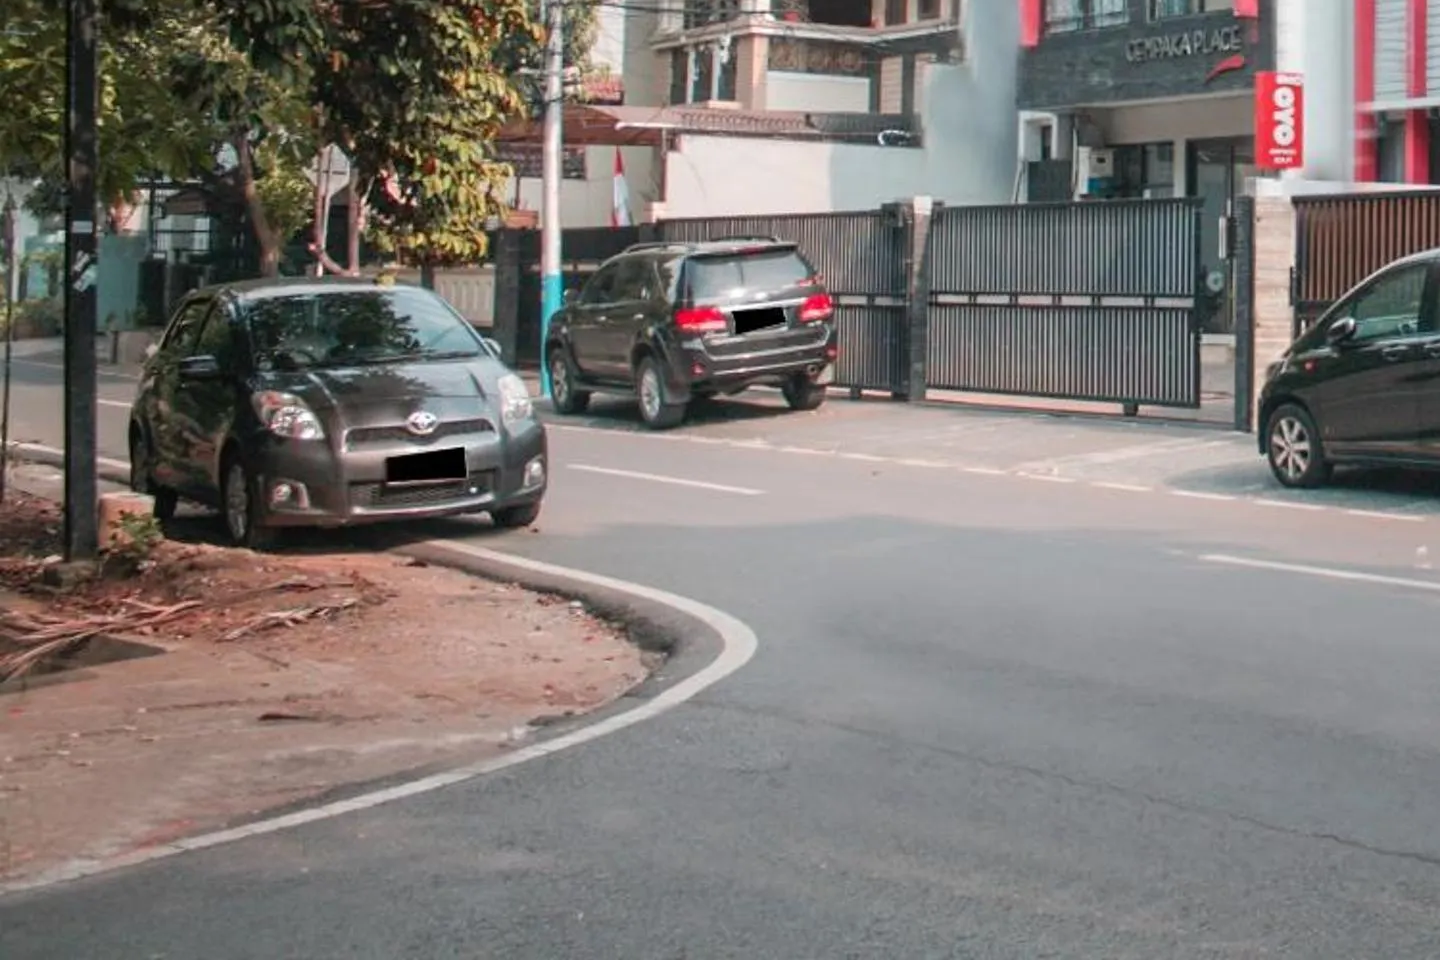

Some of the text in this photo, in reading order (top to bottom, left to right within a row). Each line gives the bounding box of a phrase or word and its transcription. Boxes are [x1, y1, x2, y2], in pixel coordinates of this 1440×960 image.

[1127, 25, 1241, 62] CEMPAKA PLACE
[1273, 86, 1295, 146] OYO
